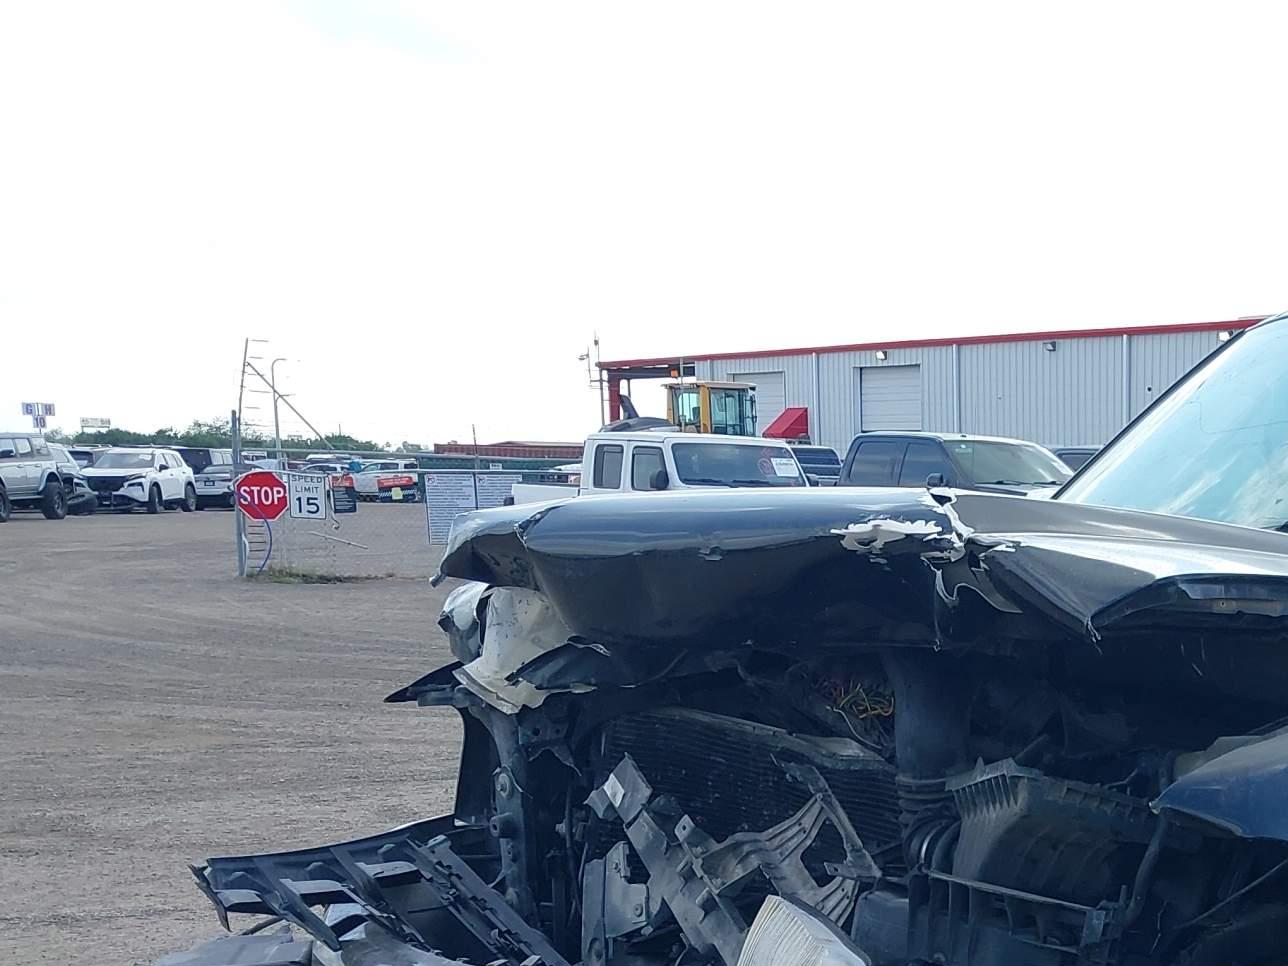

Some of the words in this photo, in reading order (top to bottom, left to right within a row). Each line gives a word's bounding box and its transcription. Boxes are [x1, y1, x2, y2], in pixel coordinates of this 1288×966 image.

[26, 403, 33, 414] G
[45, 404, 52, 415] H
[35, 417, 46, 427] 10
[292, 475, 322, 483] SPEED
[240, 486, 284, 505] STOP
[295, 486, 320, 494] LIMIT
[296, 497, 320, 514] 15
